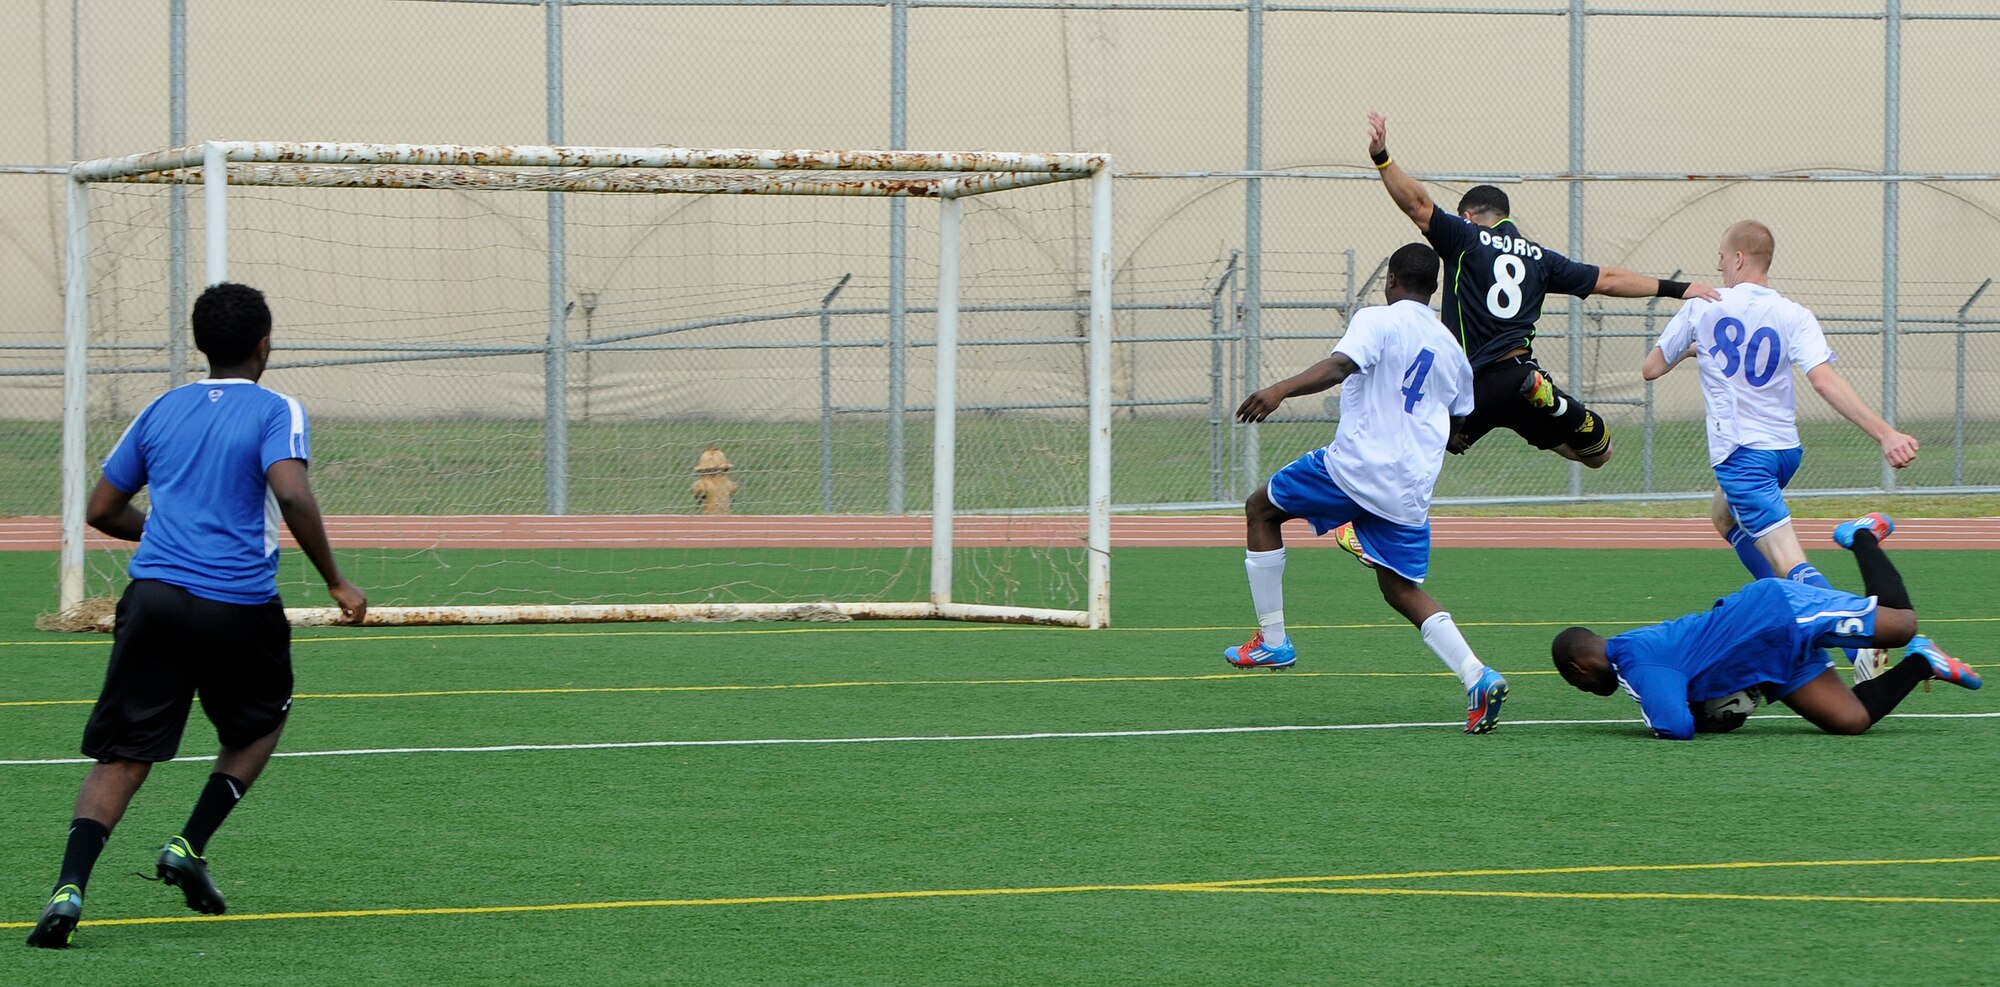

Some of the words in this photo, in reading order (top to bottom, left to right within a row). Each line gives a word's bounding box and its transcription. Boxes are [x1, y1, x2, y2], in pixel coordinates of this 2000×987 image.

[1486, 254, 1526, 319] 8
[1401, 348, 1435, 415] 4
[1709, 316, 1781, 388] 80
[1835, 617, 1864, 635] 5
